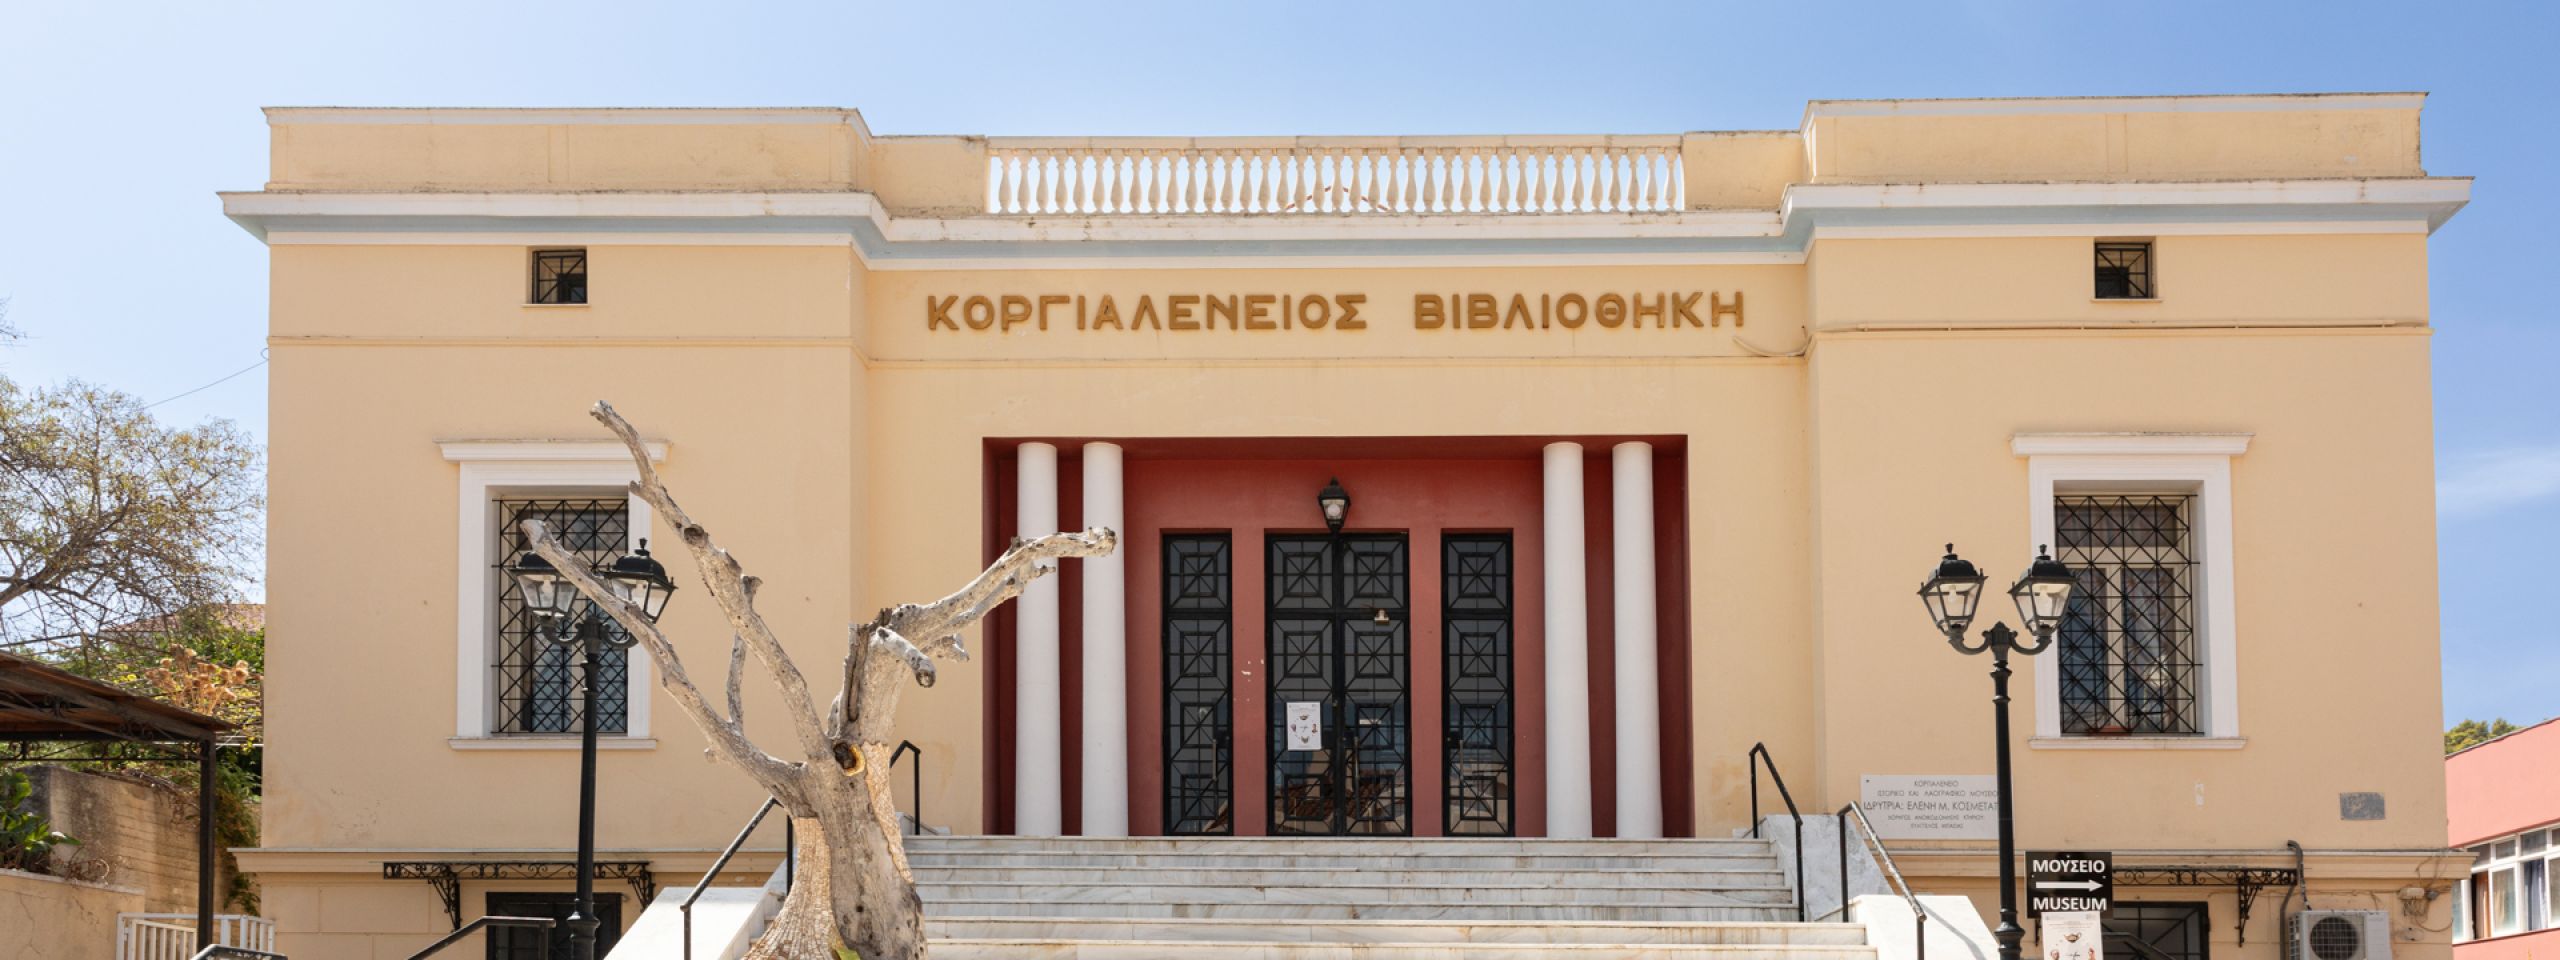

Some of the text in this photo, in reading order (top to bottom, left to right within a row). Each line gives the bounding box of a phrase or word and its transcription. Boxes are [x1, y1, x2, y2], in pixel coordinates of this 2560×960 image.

[927, 291, 1745, 332] ΚΟΡΓΙΑΛΕΝΕΙΟΣ ΒΙΒΛΙΟΘΗΚΗ
[1907, 801, 1937, 810] ΕΛΕΝΗ
[1952, 802, 2000, 811] ΚΟΣΜΕΤΑΤ
[2032, 859, 2105, 873] ΜΟΥΣΕΙΟ
[2032, 897, 2107, 911] MUSEUM
